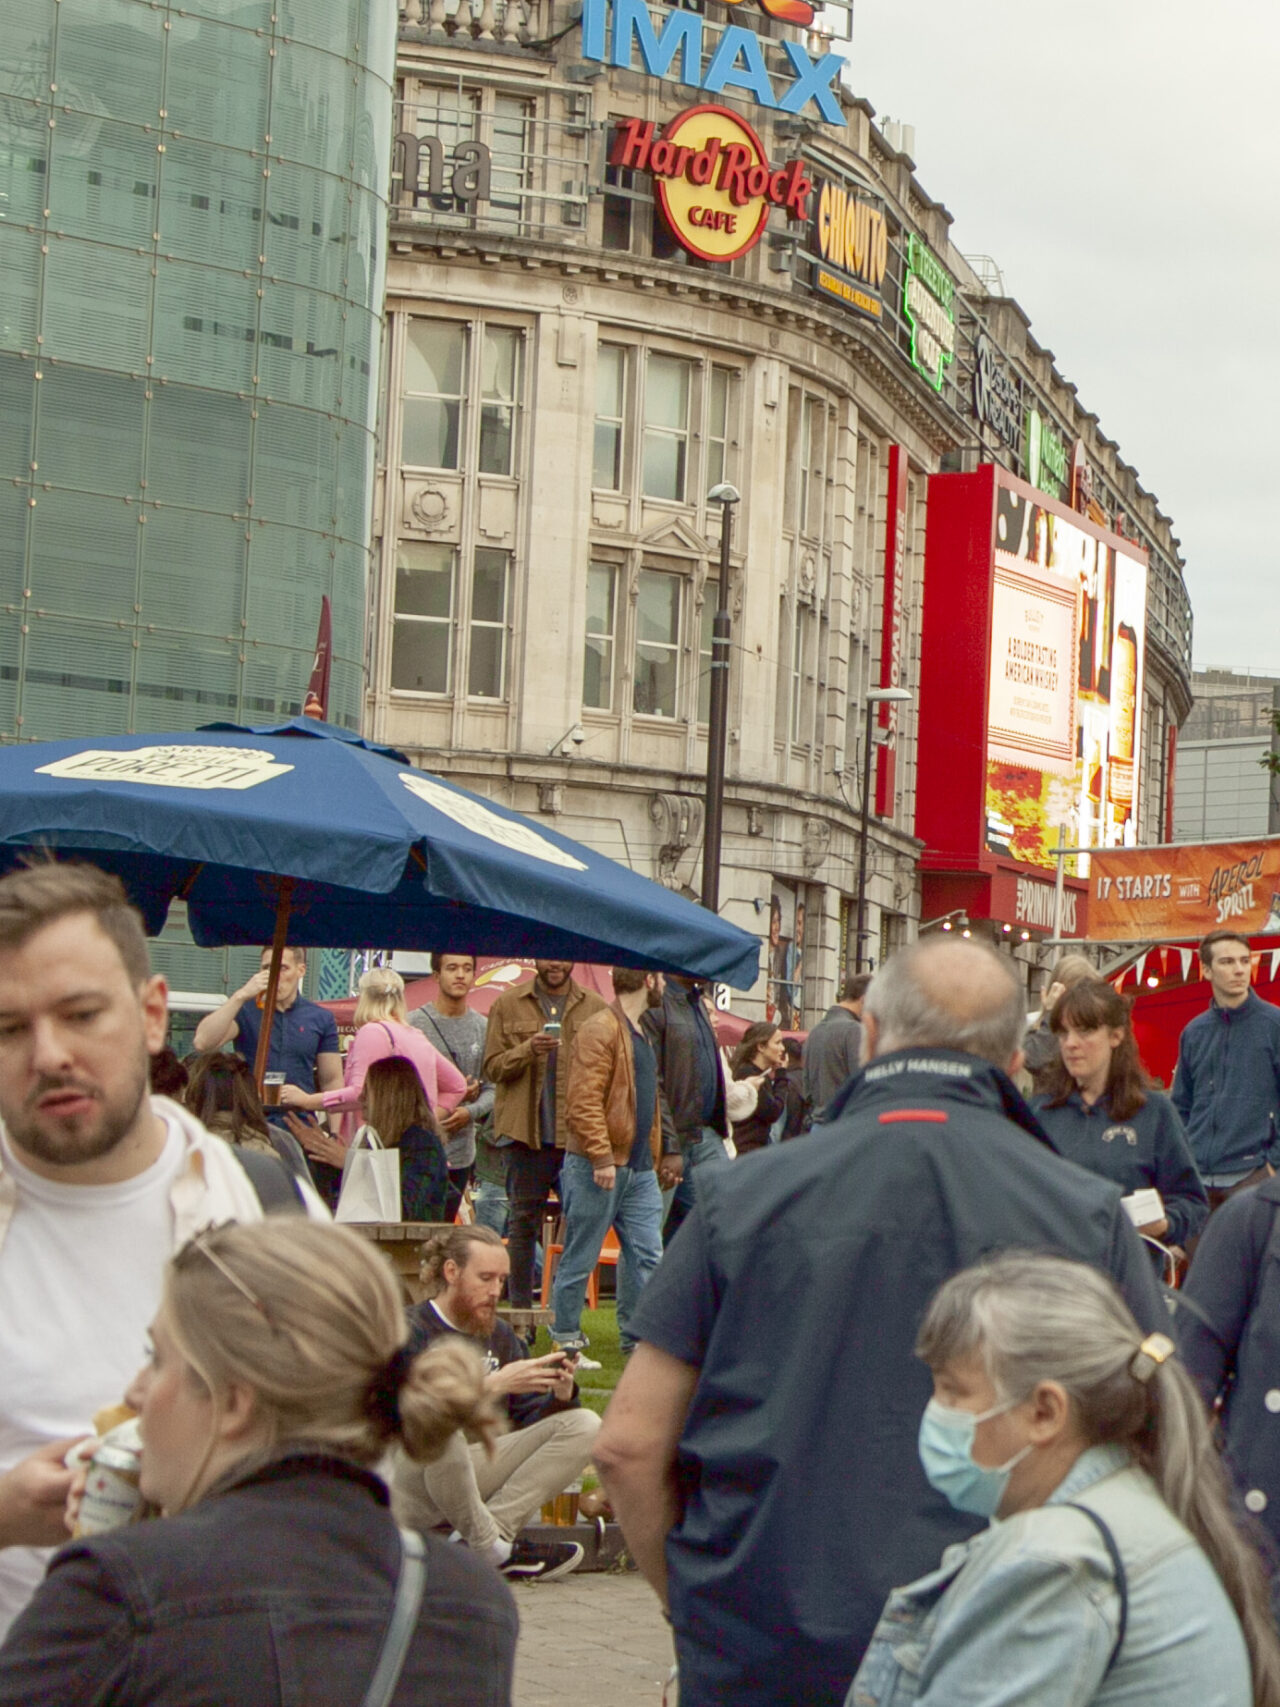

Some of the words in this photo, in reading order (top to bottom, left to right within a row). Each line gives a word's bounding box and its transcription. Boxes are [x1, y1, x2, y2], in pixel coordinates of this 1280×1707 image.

[581, 0, 848, 127] IMAX
[610, 117, 722, 186] Hard
[716, 142, 812, 221] Rock
[688, 205, 737, 234] CAFE
[818, 178, 888, 290] CHIQUITO
[65, 756, 259, 784] PORETTI
[1115, 873, 1172, 900] STARTS
[1179, 883, 1200, 898] WITH
[1207, 851, 1265, 907] APEROL
[1021, 878, 1078, 934] PRINTWRKS
[1215, 883, 1256, 924] SPRITZ
[864, 1060, 905, 1082] HELLY
[907, 1058, 972, 1079] HANSEN
